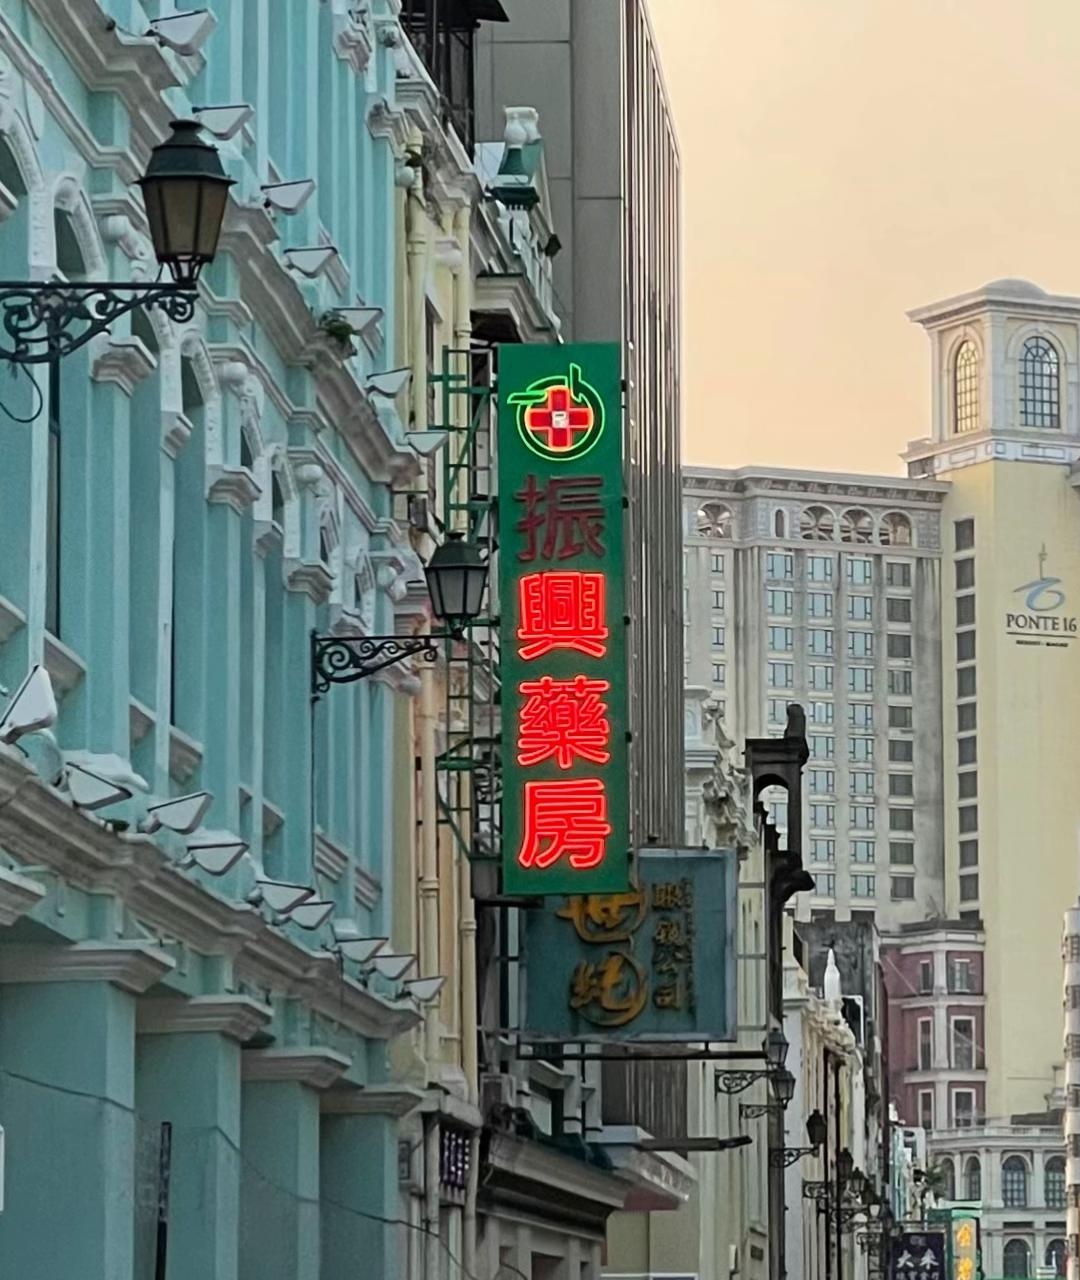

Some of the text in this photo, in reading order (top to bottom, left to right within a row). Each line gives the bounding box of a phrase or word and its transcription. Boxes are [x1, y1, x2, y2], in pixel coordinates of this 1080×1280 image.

[515, 473, 611, 870] 振興藥房
[1006, 613, 1077, 632] PONTE 16
